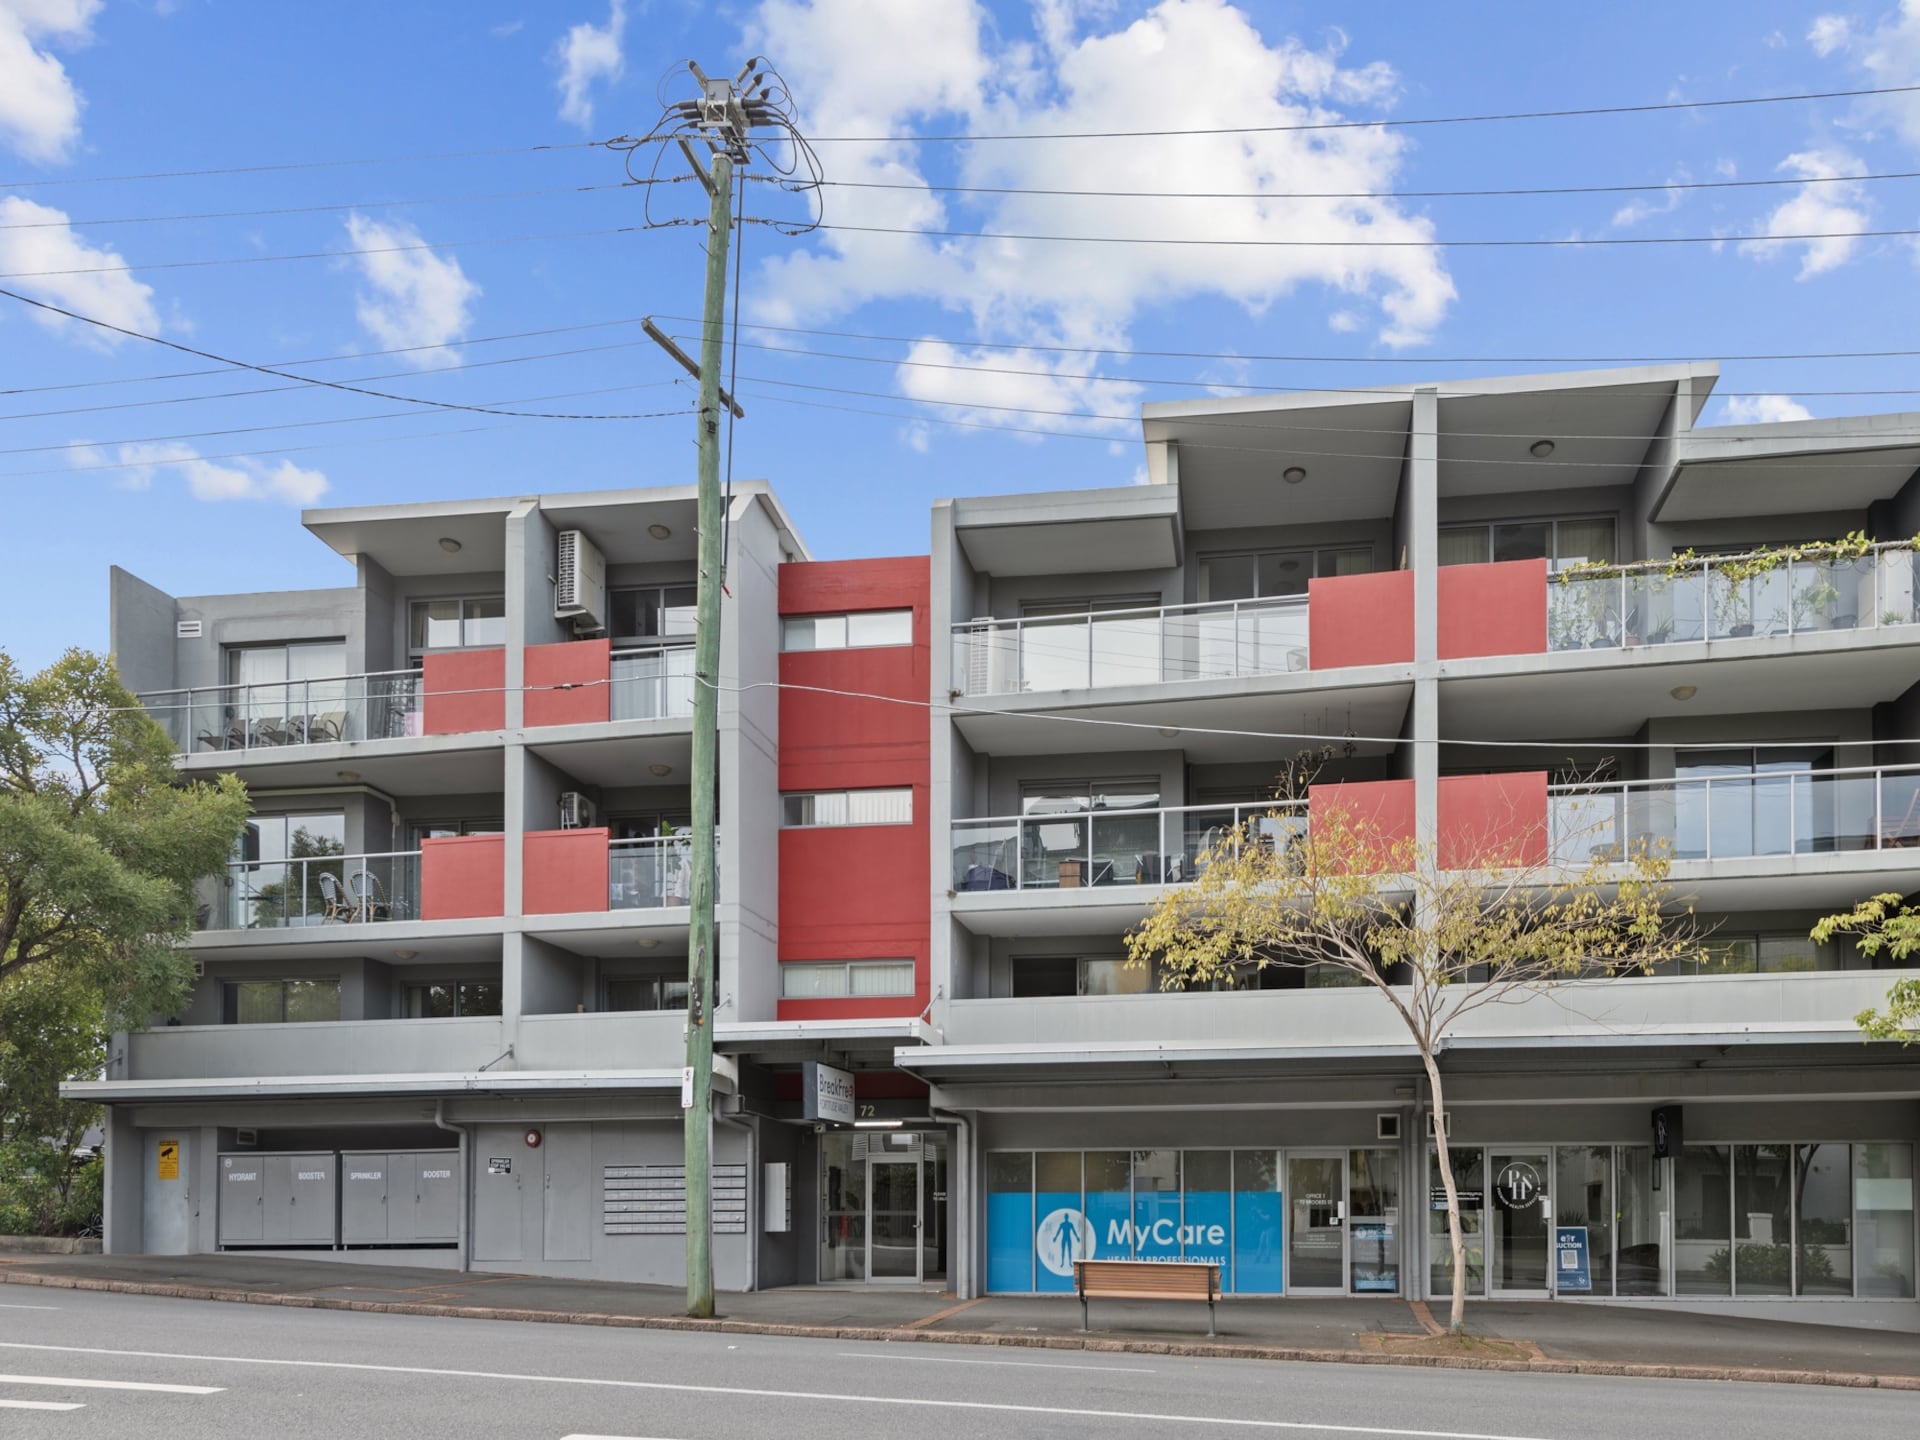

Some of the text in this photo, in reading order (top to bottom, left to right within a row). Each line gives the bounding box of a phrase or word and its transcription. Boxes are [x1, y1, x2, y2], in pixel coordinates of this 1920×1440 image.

[819, 1073, 854, 1098] BreakFree
[860, 1105, 875, 1117] 72
[228, 1171, 326, 1182] HYDRANT BOOSTER
[350, 1169, 451, 1181] SPRINKLER BOOSTER
[1107, 1219, 1225, 1251] MyCare
